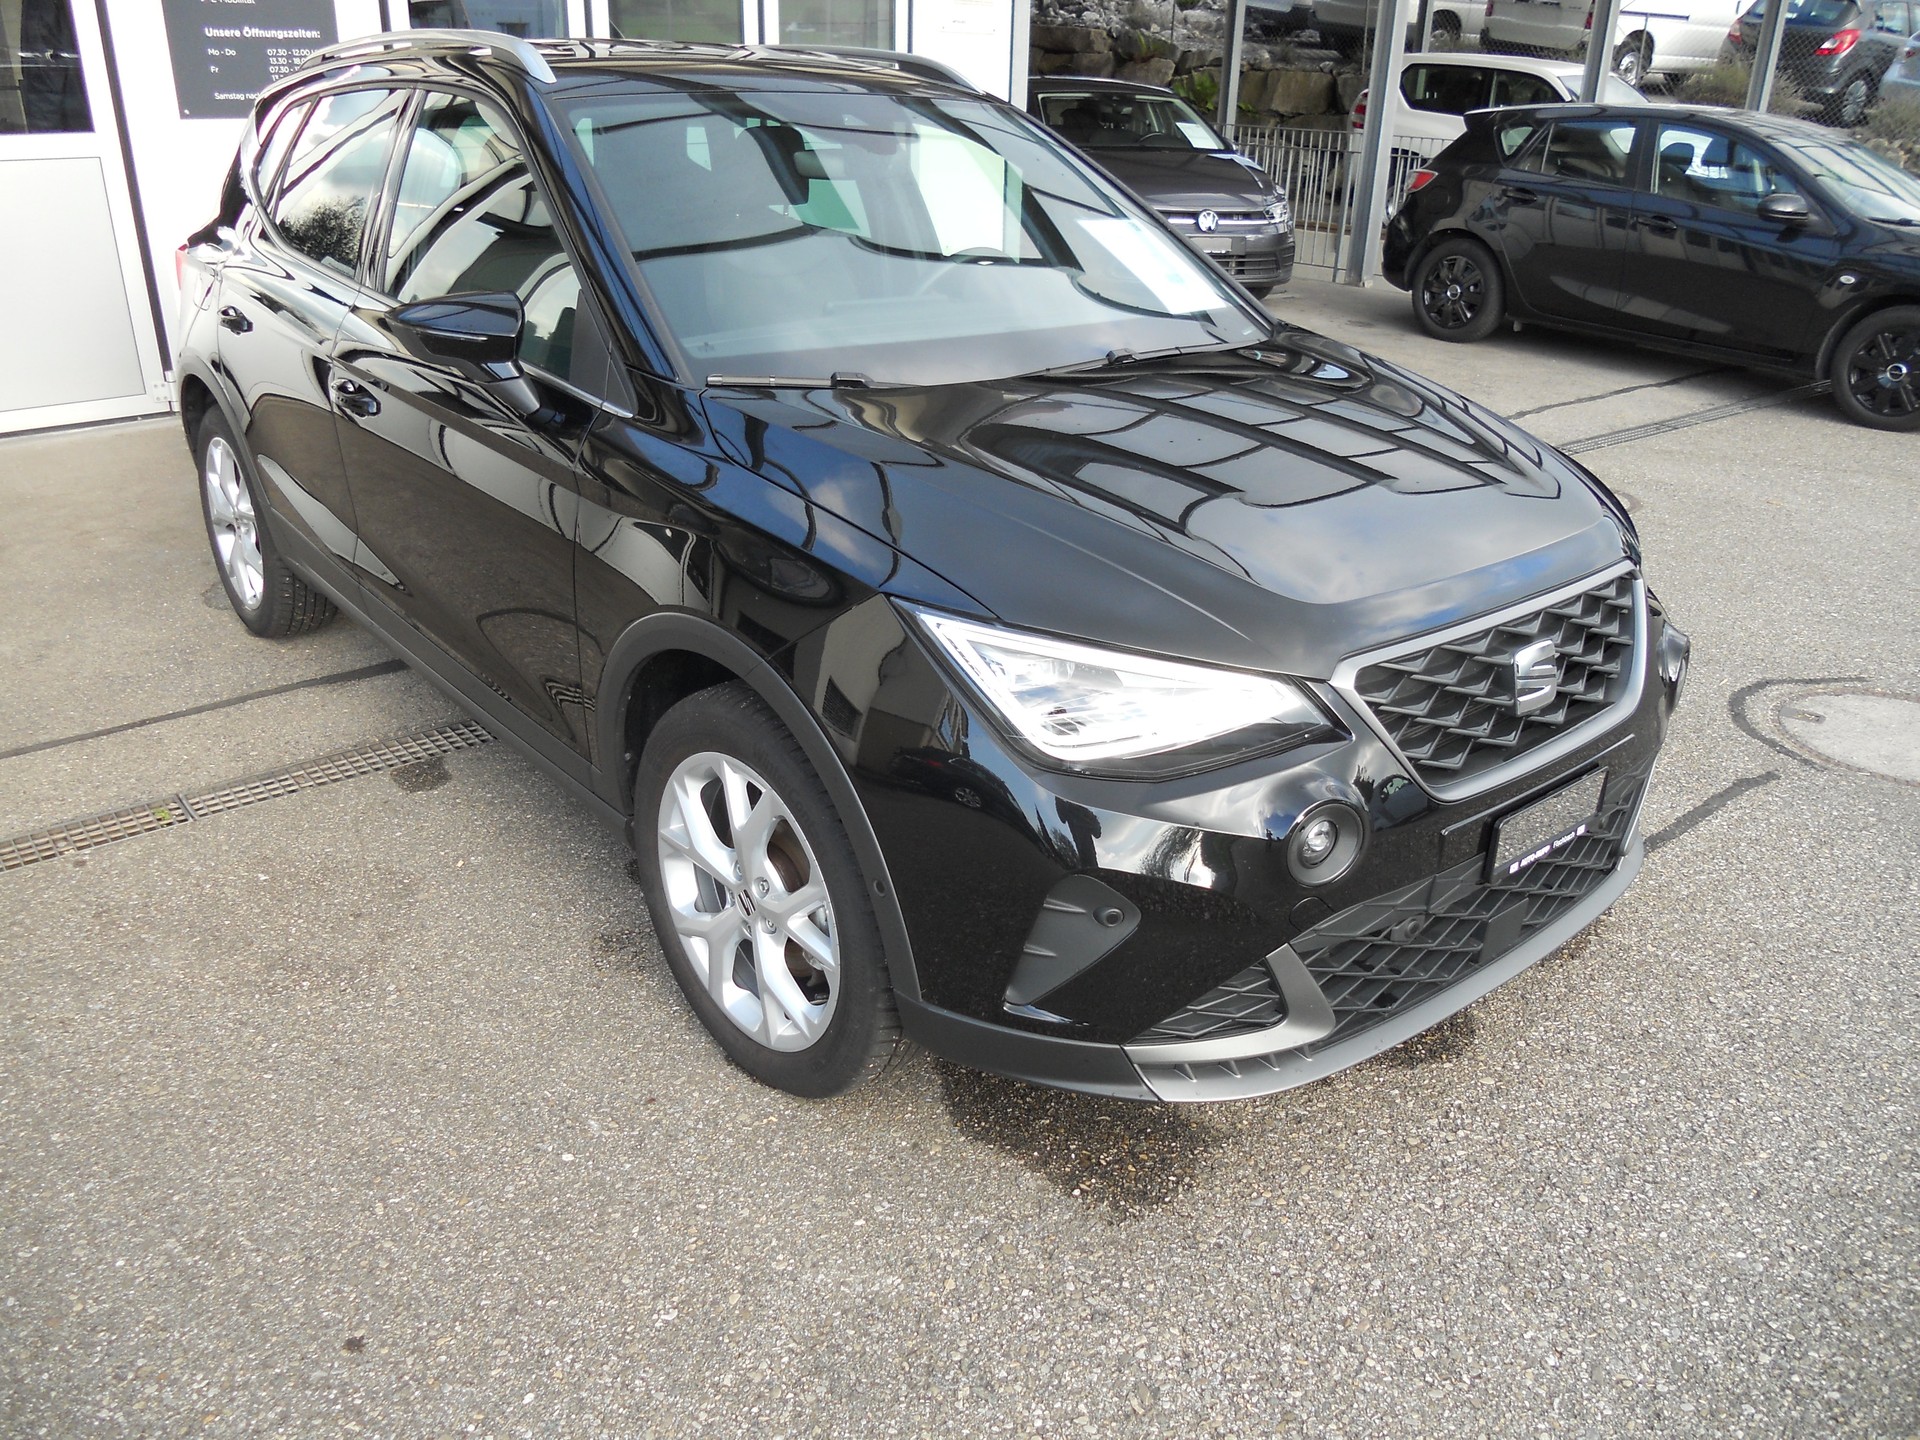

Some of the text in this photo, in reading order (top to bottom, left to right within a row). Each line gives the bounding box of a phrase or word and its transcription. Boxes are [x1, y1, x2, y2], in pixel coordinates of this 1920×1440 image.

[204, 26, 321, 40] Unsere Öffnungszeiten:
[207, 48, 220, 56] Mo
[225, 48, 237, 56] Do
[267, 48, 288, 56] 07.30
[292, 48, 311, 57] 12.00
[269, 57, 288, 65] 13.30
[210, 66, 219, 74] Fr
[269, 66, 290, 74] 07.30
[214, 92, 245, 101] Samstag
